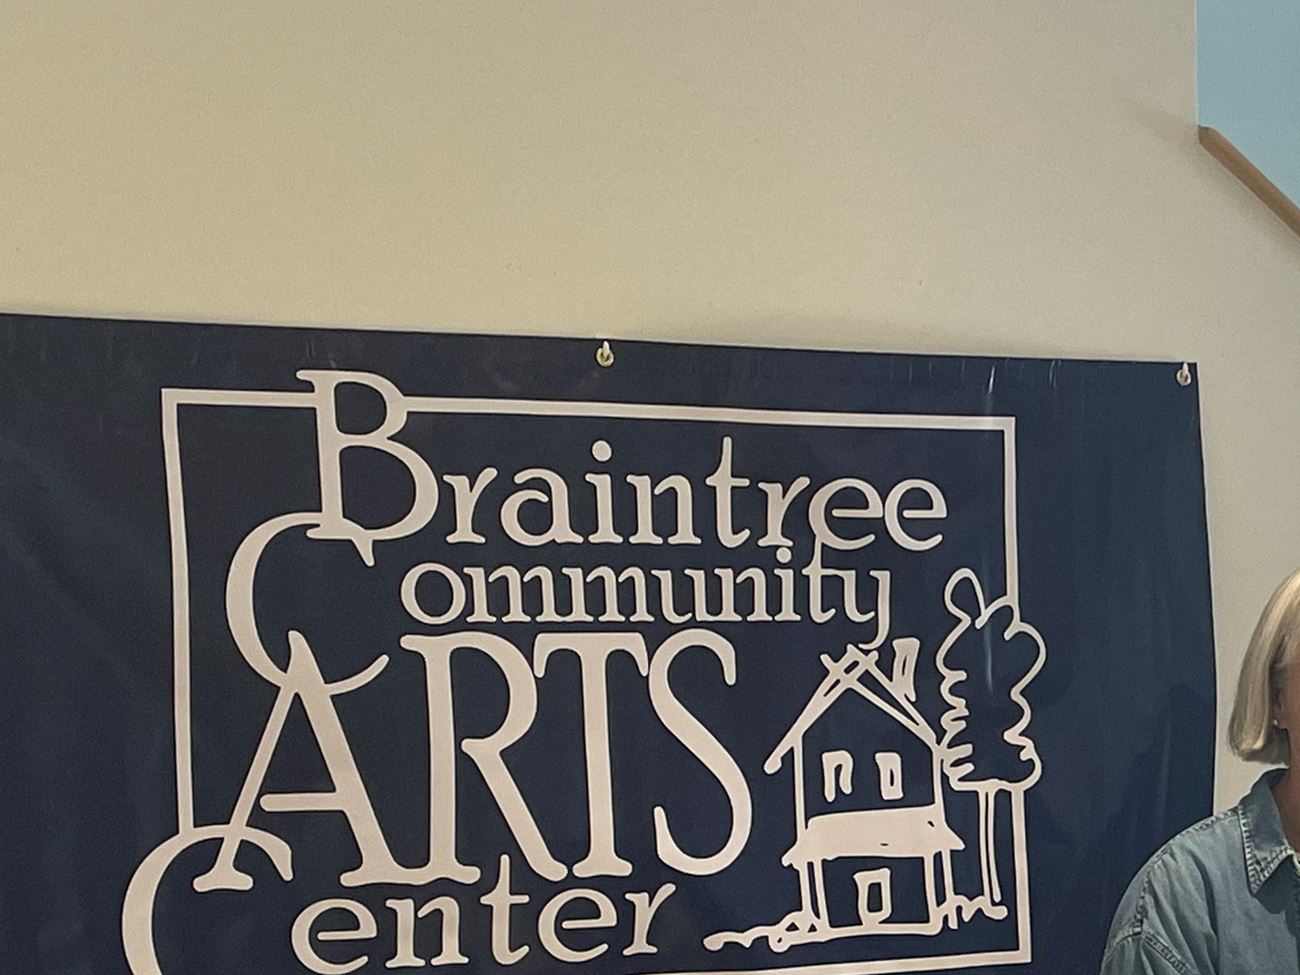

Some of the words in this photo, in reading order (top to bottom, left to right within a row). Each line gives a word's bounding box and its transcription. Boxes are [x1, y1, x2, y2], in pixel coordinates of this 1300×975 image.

[296, 369, 947, 551] Braintree
[225, 512, 891, 697] Community
[193, 629, 753, 891] ARTS
